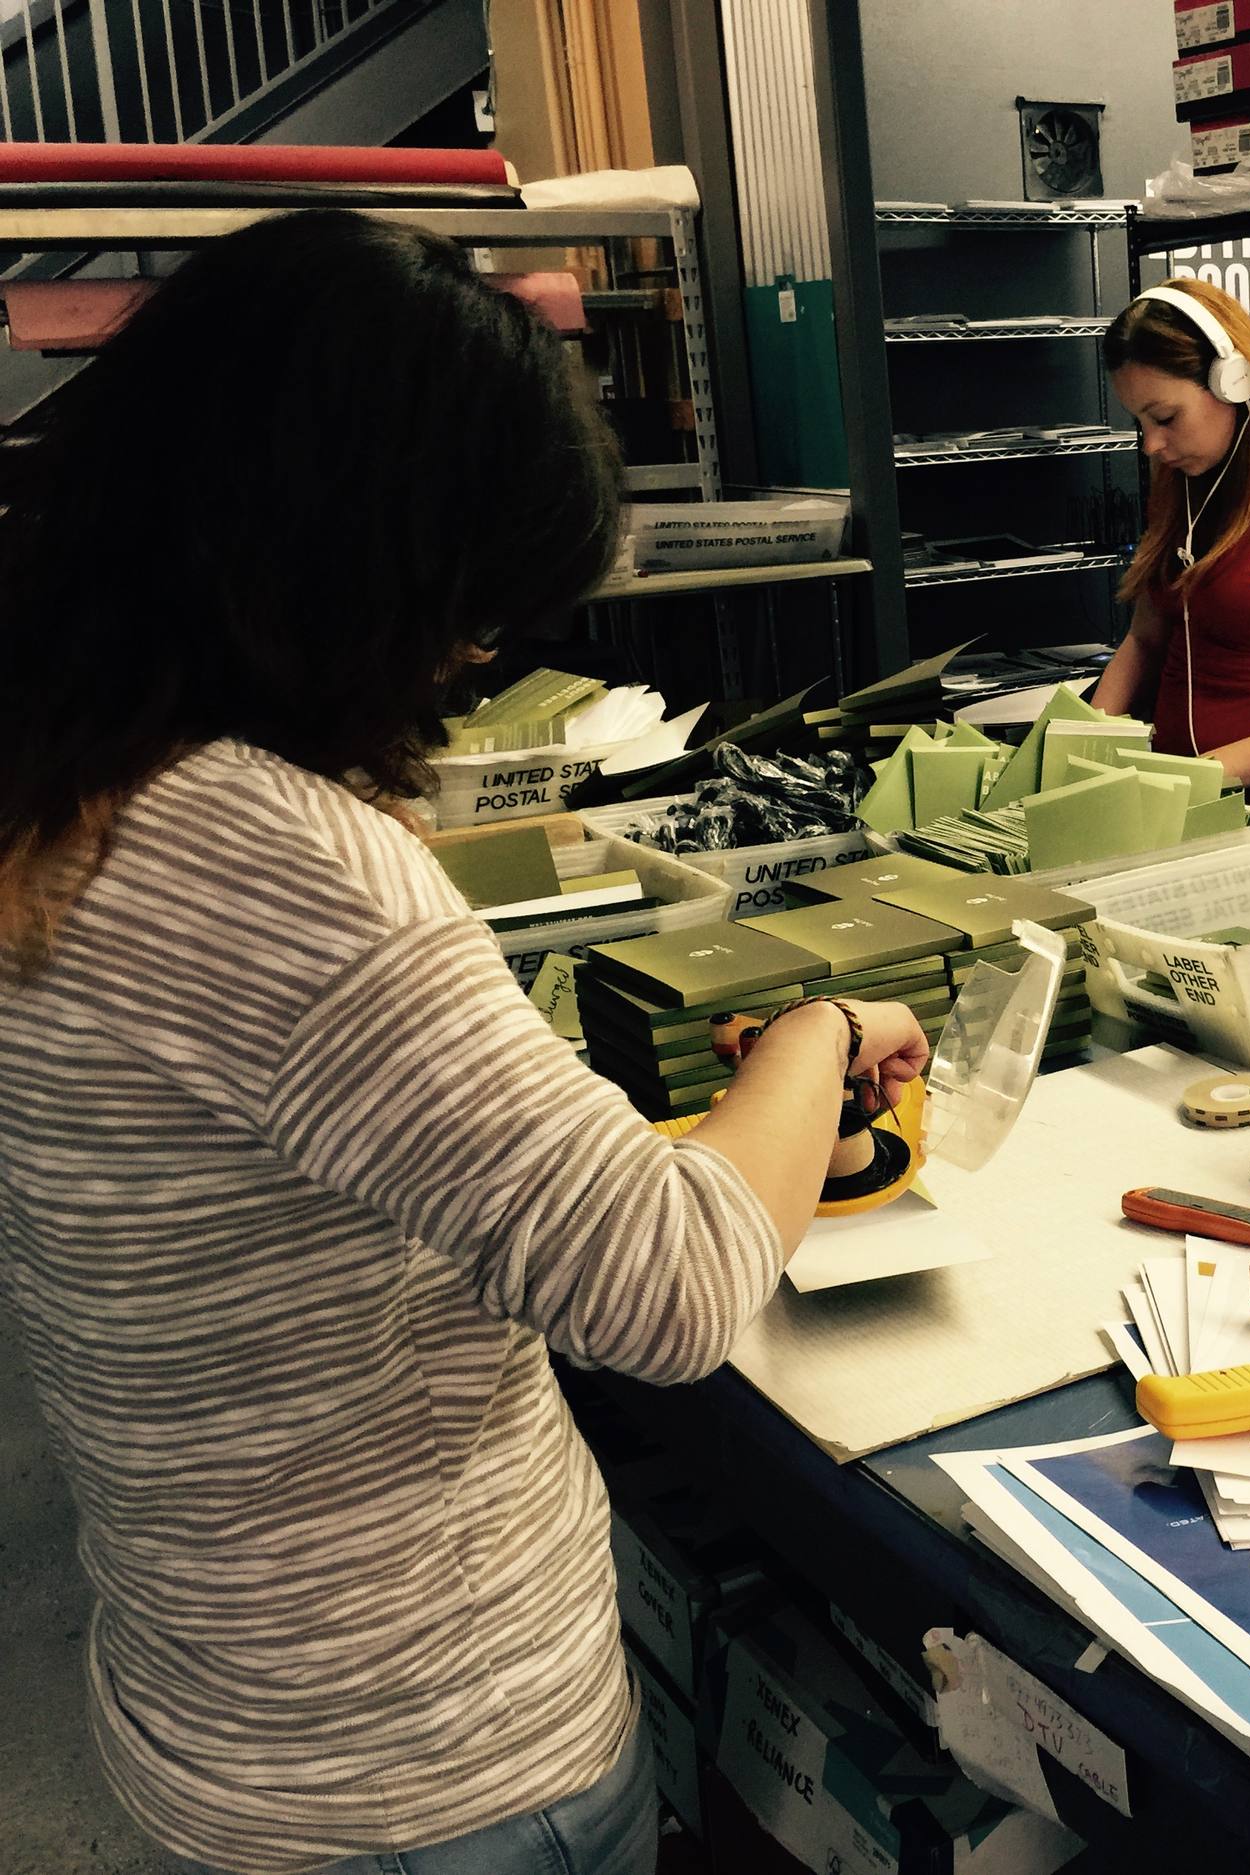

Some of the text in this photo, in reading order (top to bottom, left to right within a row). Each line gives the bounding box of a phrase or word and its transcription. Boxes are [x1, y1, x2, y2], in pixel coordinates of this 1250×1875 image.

[655, 532, 817, 550] UNITED STATES POSTAL SERVICE
[482, 767, 554, 789] UNITED
[475, 788, 551, 813] POSTAL
[745, 856, 826, 884] UNITED
[1162, 953, 1214, 976] LABEL
[1169, 970, 1220, 993] OTHER
[1185, 987, 1216, 1006] END
[640, 1547, 676, 1602] XENEX
[756, 1673, 801, 1738] XENEX
[1016, 1701, 1064, 1755] DTV
[746, 1718, 814, 1806] RELIANCE
